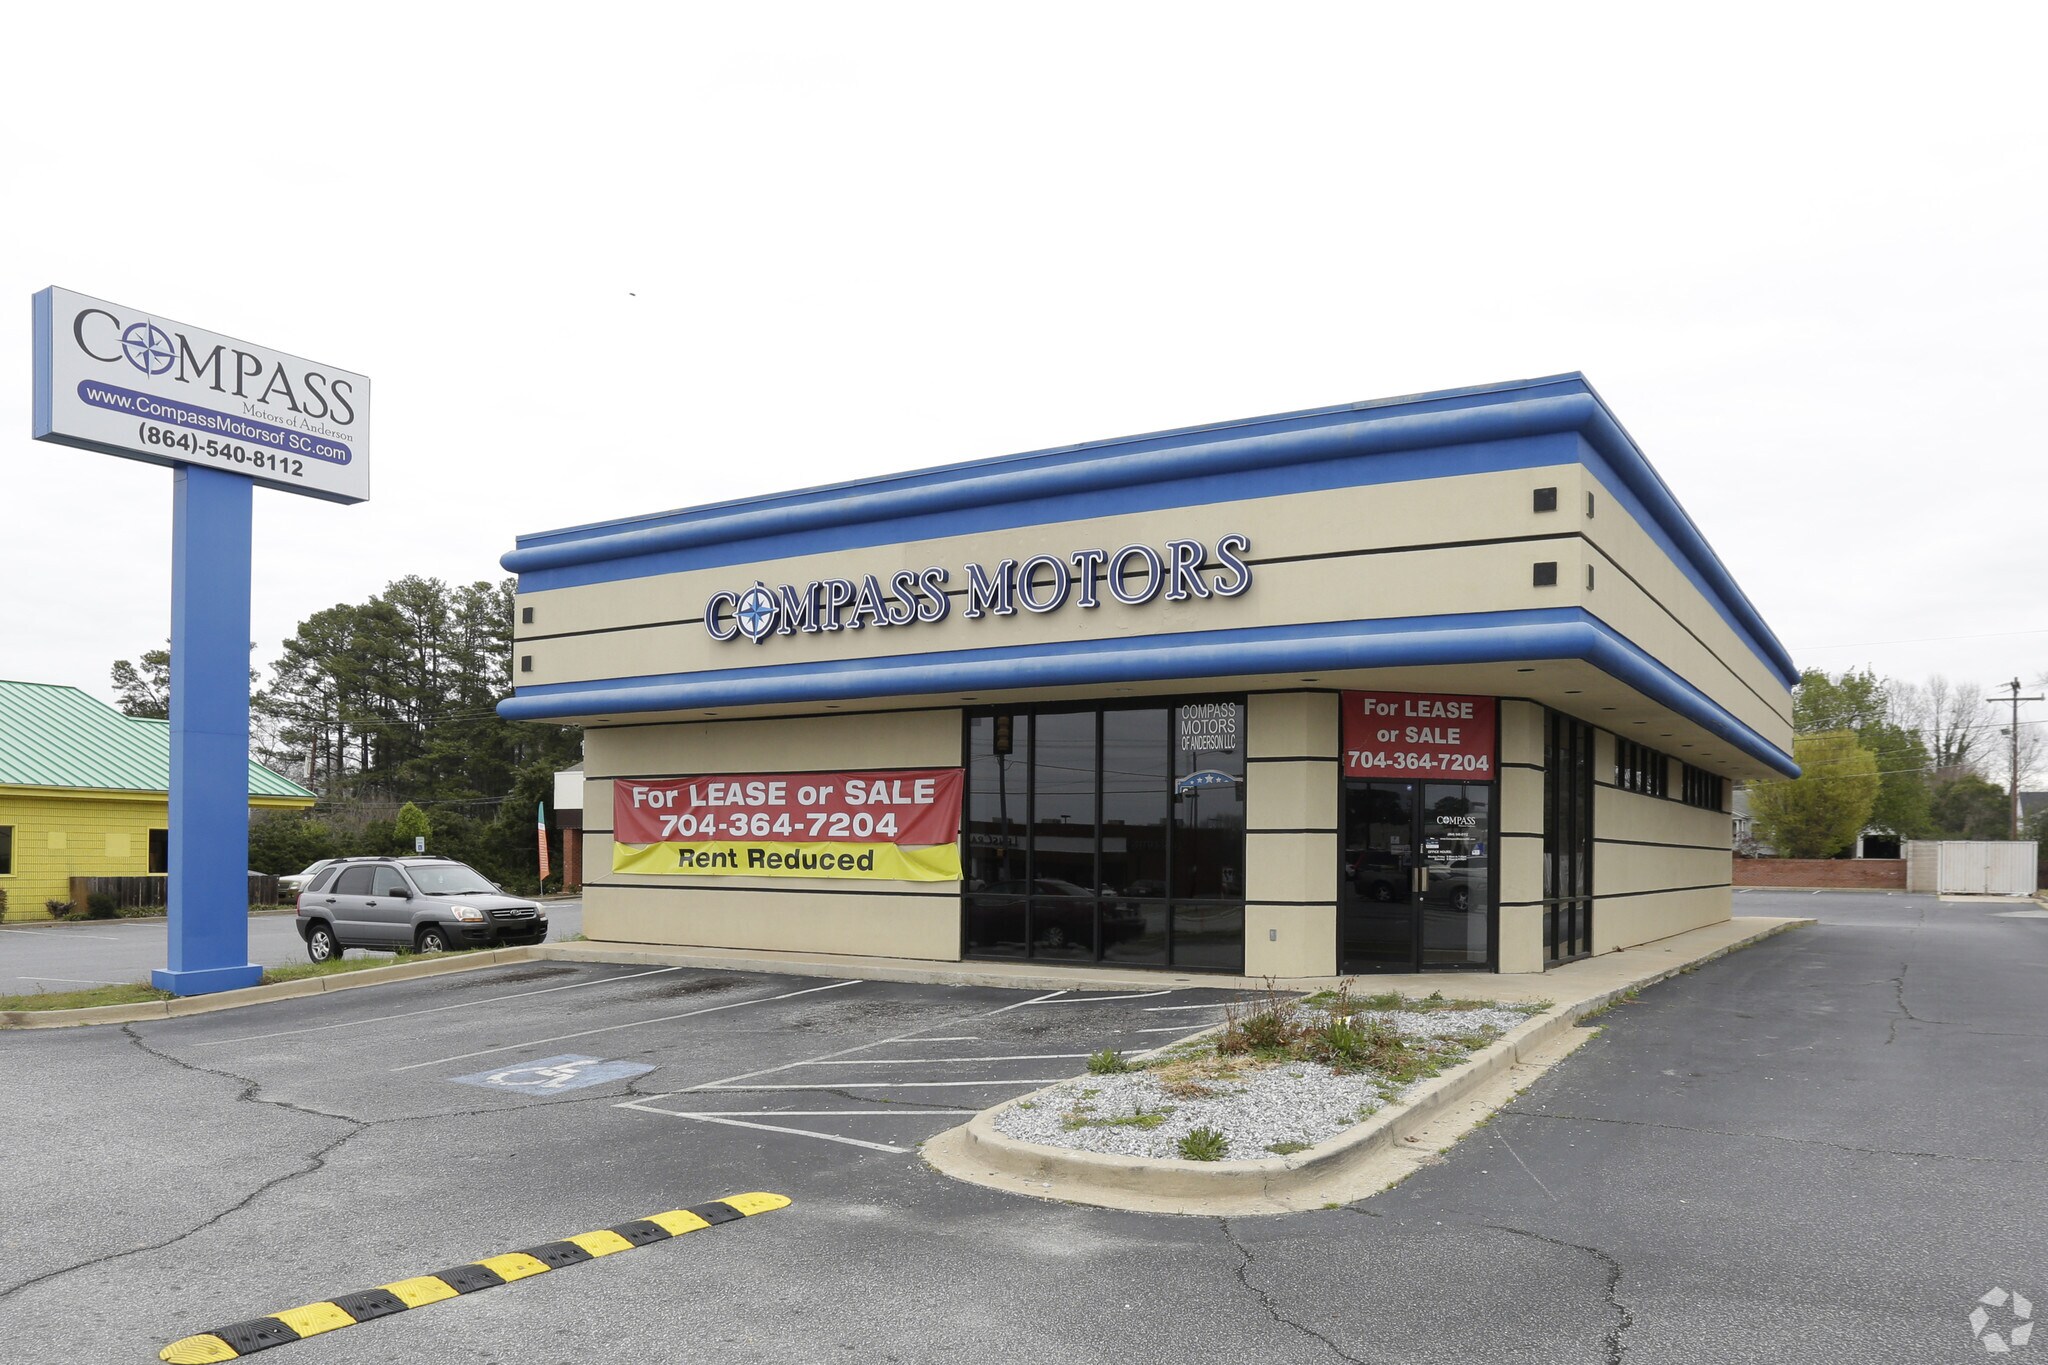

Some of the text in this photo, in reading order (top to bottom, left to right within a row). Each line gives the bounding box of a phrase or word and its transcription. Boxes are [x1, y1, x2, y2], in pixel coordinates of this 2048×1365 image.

[73, 308, 355, 425] COMPASS
[86, 385, 347, 461] www.CompassMotorsof SC.com
[242, 401, 354, 442] Motors of Anderson
[138, 422, 304, 477] (864)-540-8112
[703, 532, 1252, 645] COMPASS MOTORS
[1181, 702, 1236, 719] COMPASS
[1364, 698, 1474, 719] For LEASE
[1181, 718, 1236, 735] MOTORS
[1376, 726, 1461, 745] or SALE
[1181, 734, 1236, 750] OF ANDERSON LLC
[1348, 751, 1489, 771] 704-364-7204
[632, 778, 936, 808] For LEASE or SALE
[659, 812, 898, 838] 704-364-7204
[1436, 815, 1476, 825] COMPASS
[678, 848, 874, 872] Rent Reduced
